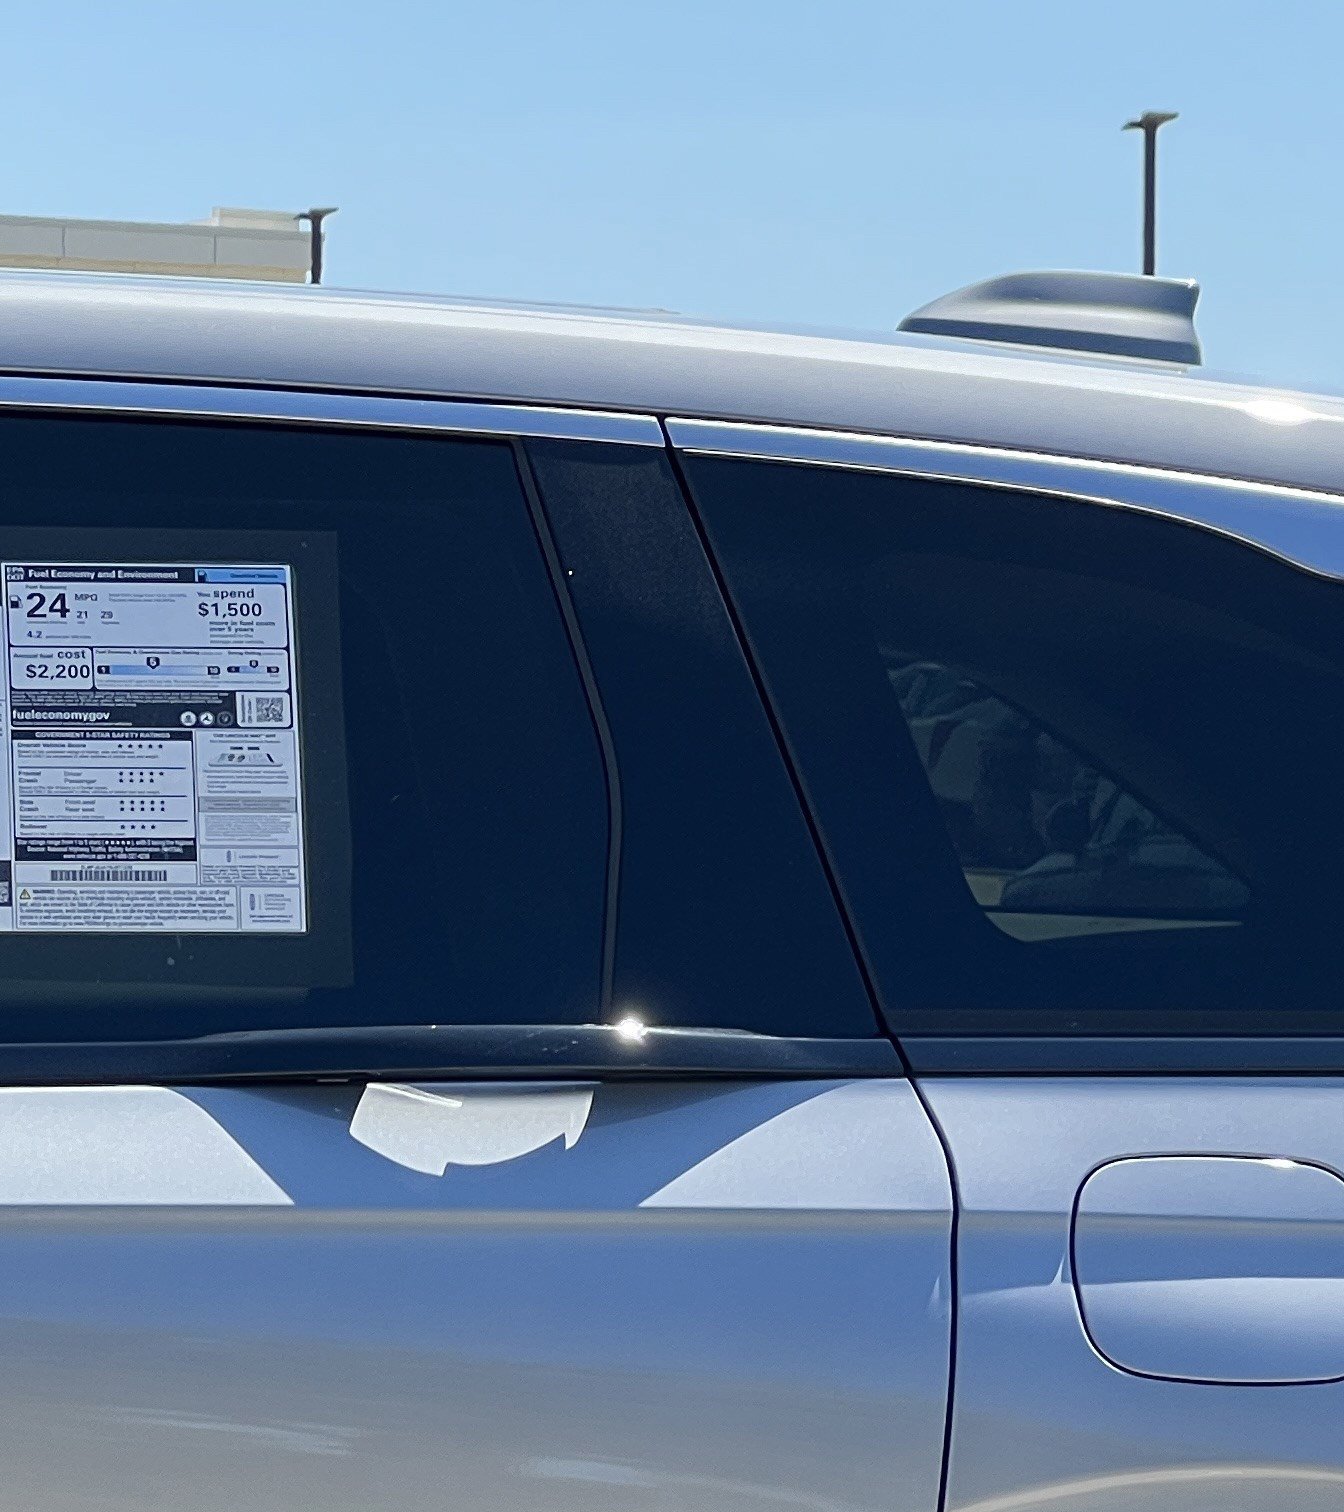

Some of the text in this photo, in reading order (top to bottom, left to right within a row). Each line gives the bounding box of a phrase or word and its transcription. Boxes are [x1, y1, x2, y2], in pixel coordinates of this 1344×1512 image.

[28, 569, 179, 580] Fuel Economy and Environment
[74, 593, 98, 602] MPG
[213, 588, 255, 600] spend
[26, 592, 70, 618] 24
[198, 601, 262, 618] $1,500
[57, 650, 86, 659] cost
[26, 664, 90, 680] $2,200
